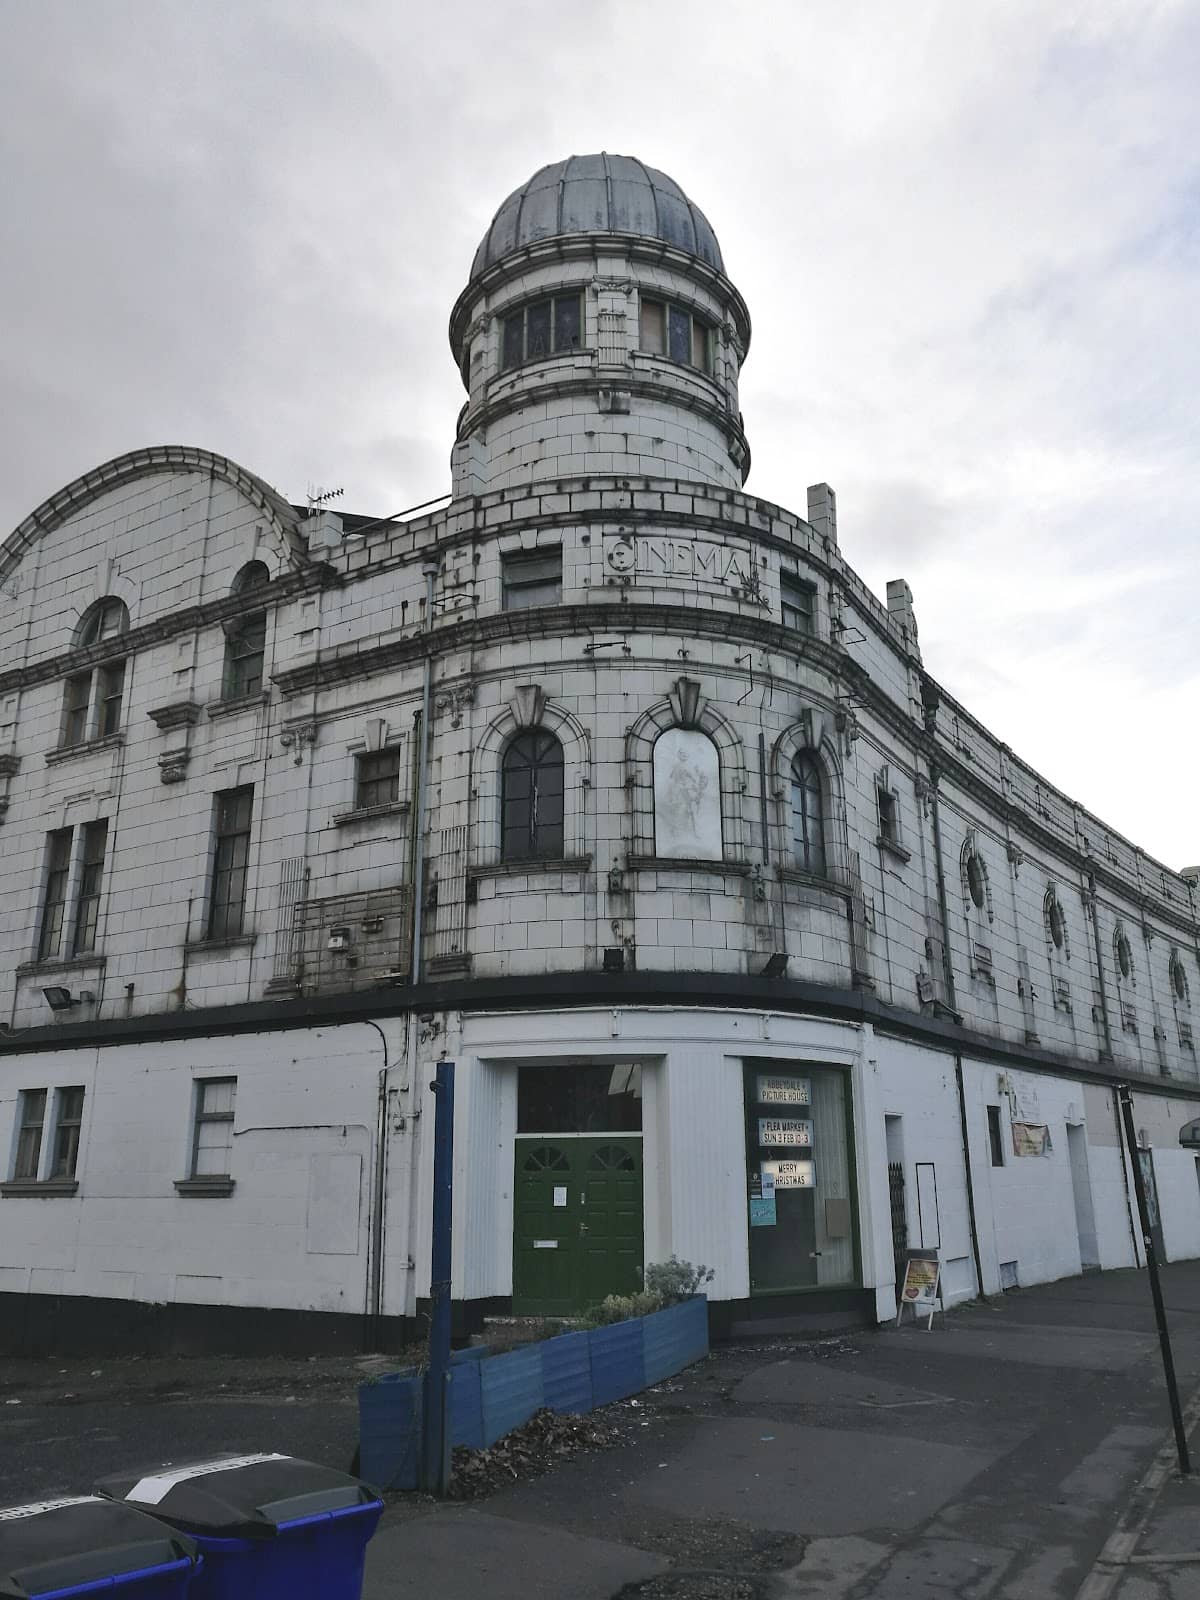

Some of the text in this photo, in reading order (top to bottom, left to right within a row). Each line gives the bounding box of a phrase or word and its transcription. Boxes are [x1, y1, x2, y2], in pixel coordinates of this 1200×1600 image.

[607, 541, 751, 585] CINEMA
[762, 1090, 808, 1102] PICTURE HOUSE
[766, 1121, 805, 1132] FLEA MARKET
[764, 1133, 777, 1143] SUN
[783, 1133, 795, 1143] FEB
[778, 1163, 797, 1173] MERRY
[775, 1175, 806, 1185] HRISTMAS
